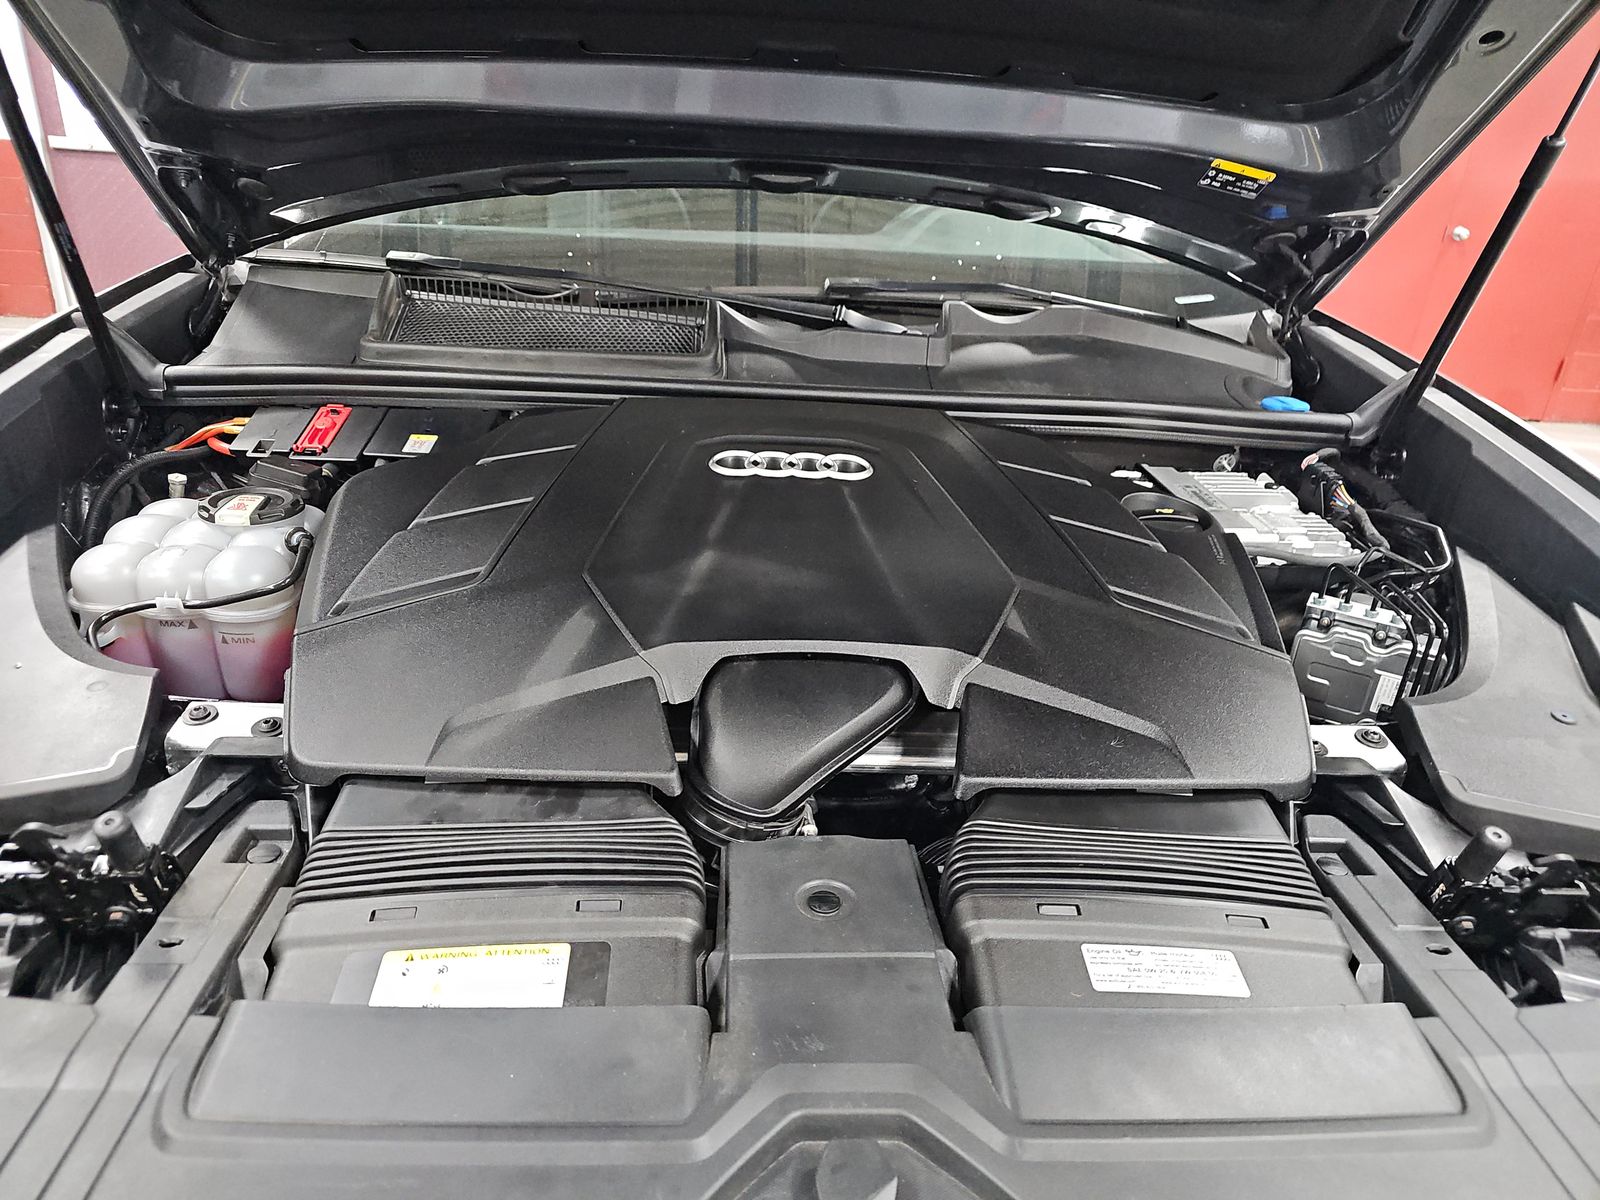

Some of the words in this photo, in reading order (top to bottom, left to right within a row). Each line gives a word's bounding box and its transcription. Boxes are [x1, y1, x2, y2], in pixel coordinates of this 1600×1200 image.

[159, 619, 185, 628] MAX
[231, 636, 255, 645] MIN
[420, 951, 478, 961] WARNING
[485, 948, 551, 958] ATTENTION
